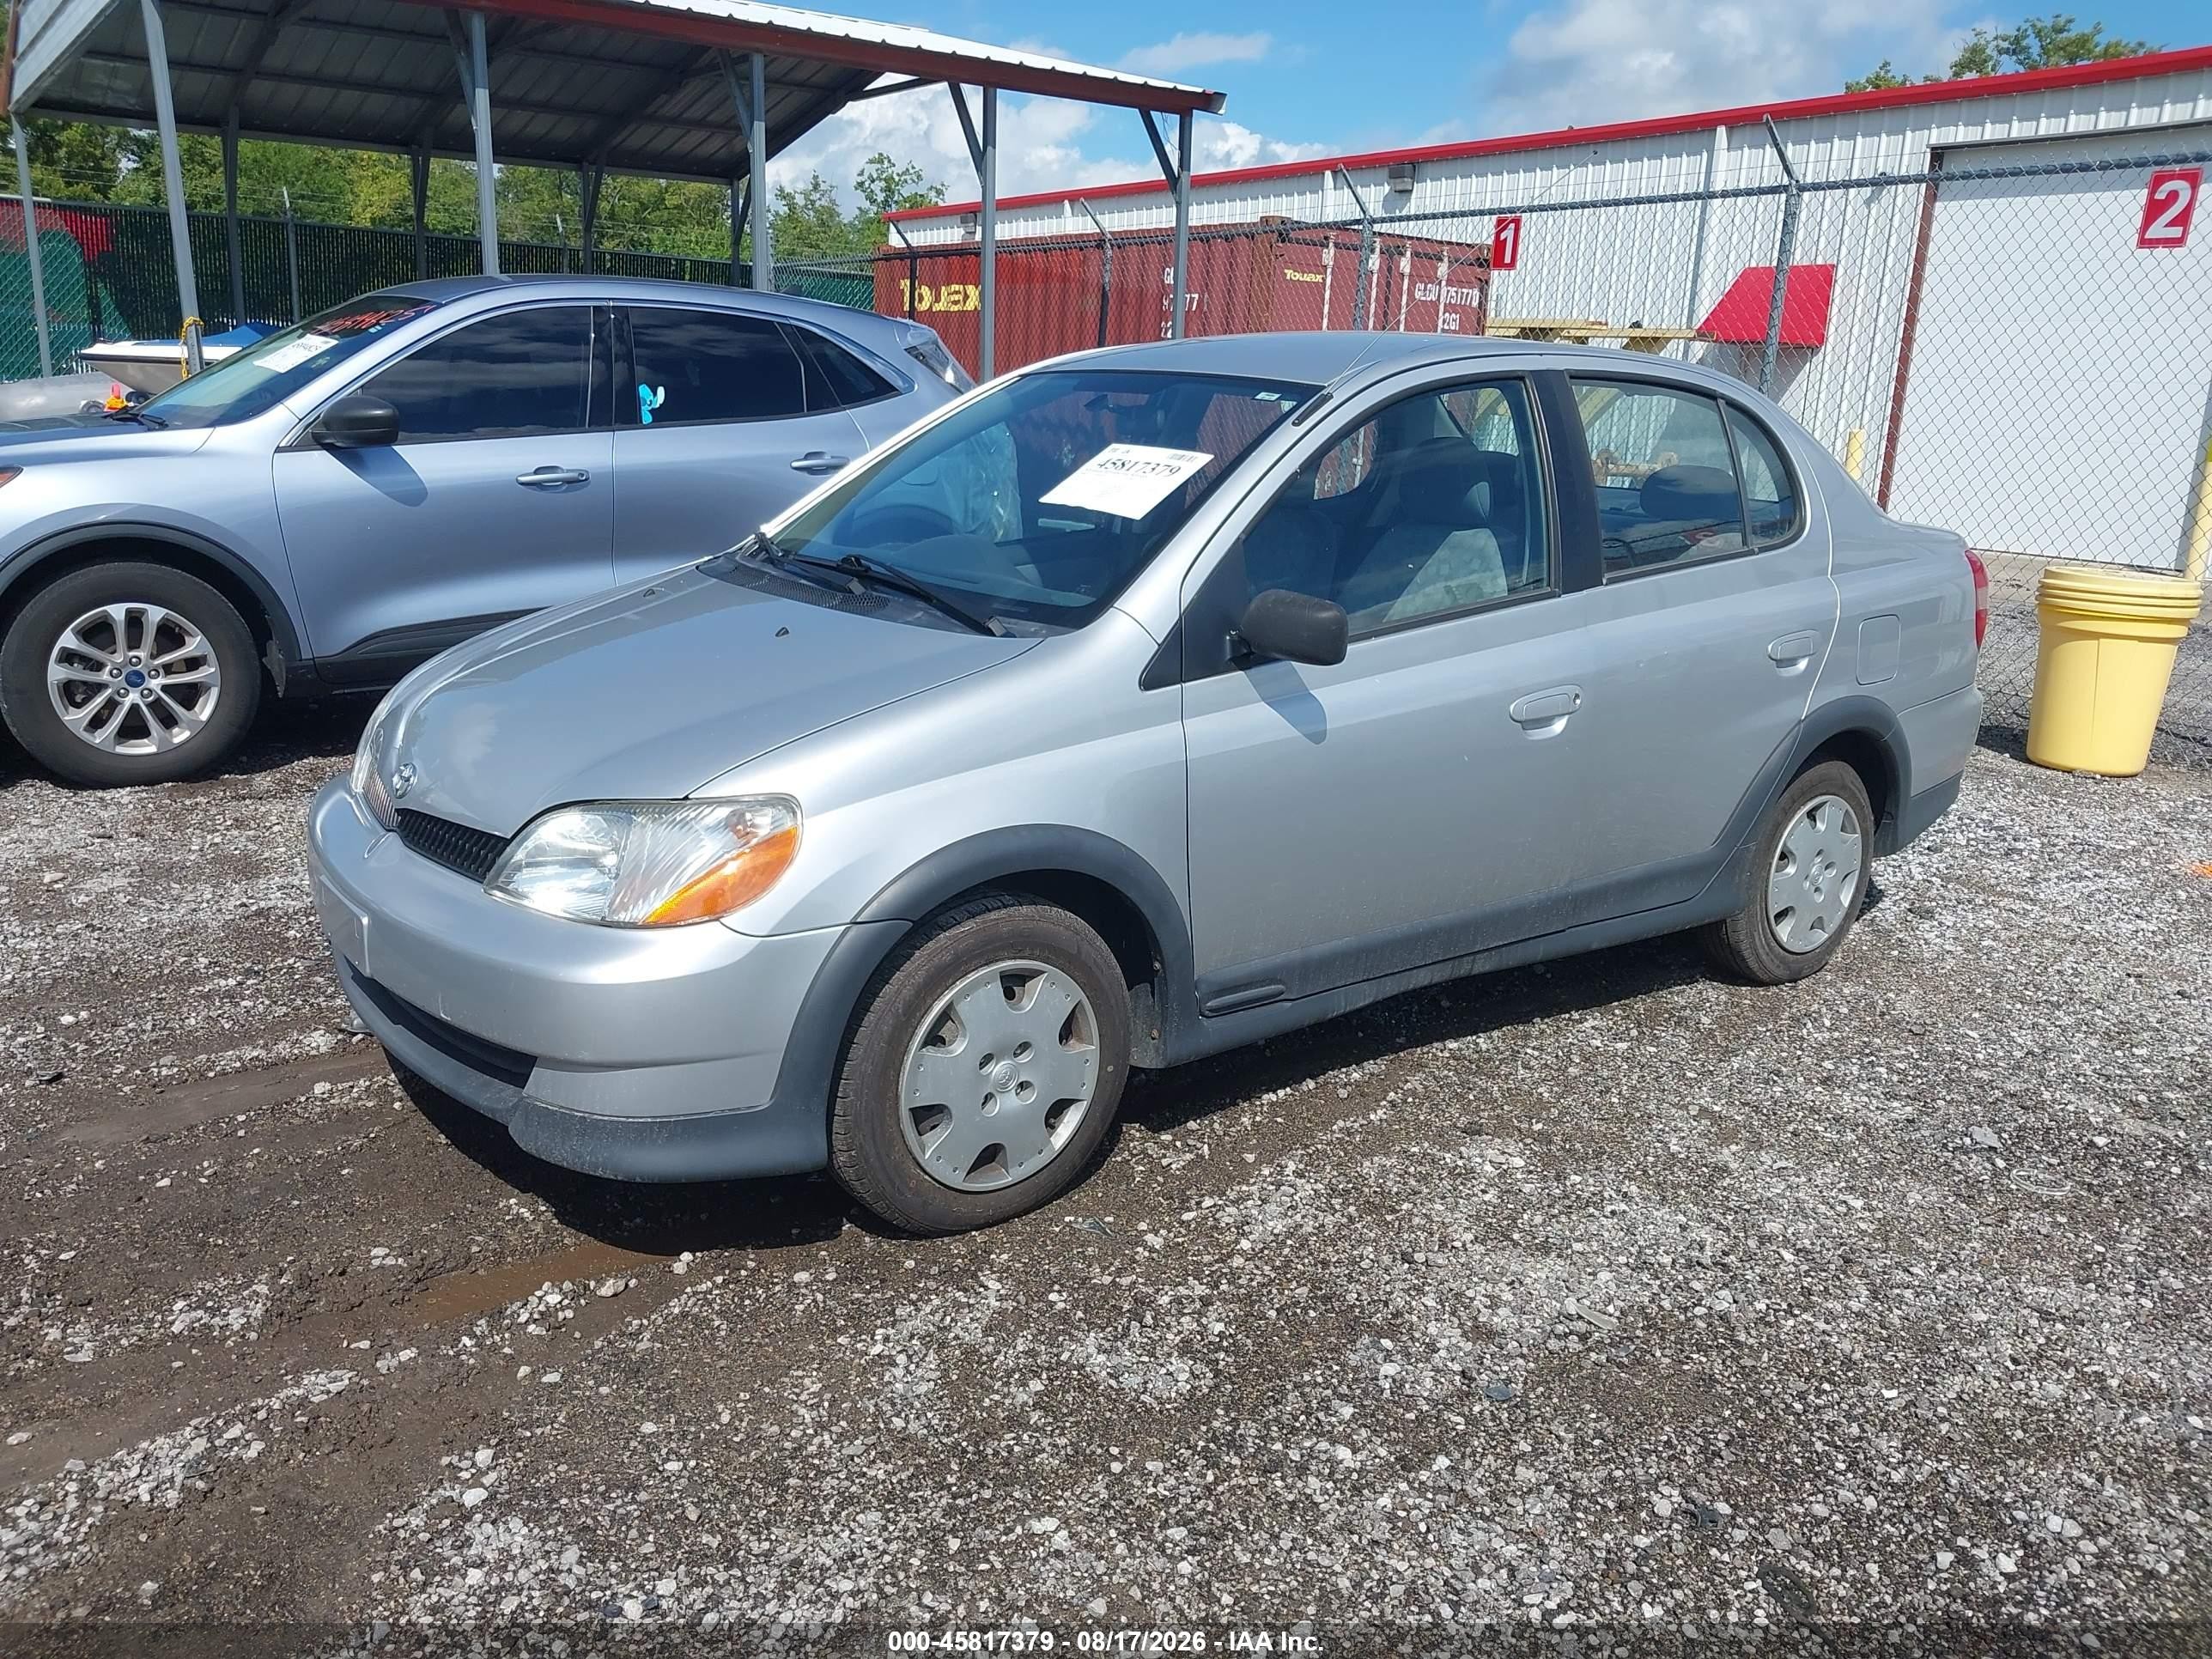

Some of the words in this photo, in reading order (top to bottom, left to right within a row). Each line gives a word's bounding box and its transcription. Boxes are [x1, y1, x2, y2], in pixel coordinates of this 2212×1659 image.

[2144, 179, 2191, 239] 2
[1499, 222, 1516, 264] 1
[1097, 458, 1182, 477] 45817379
